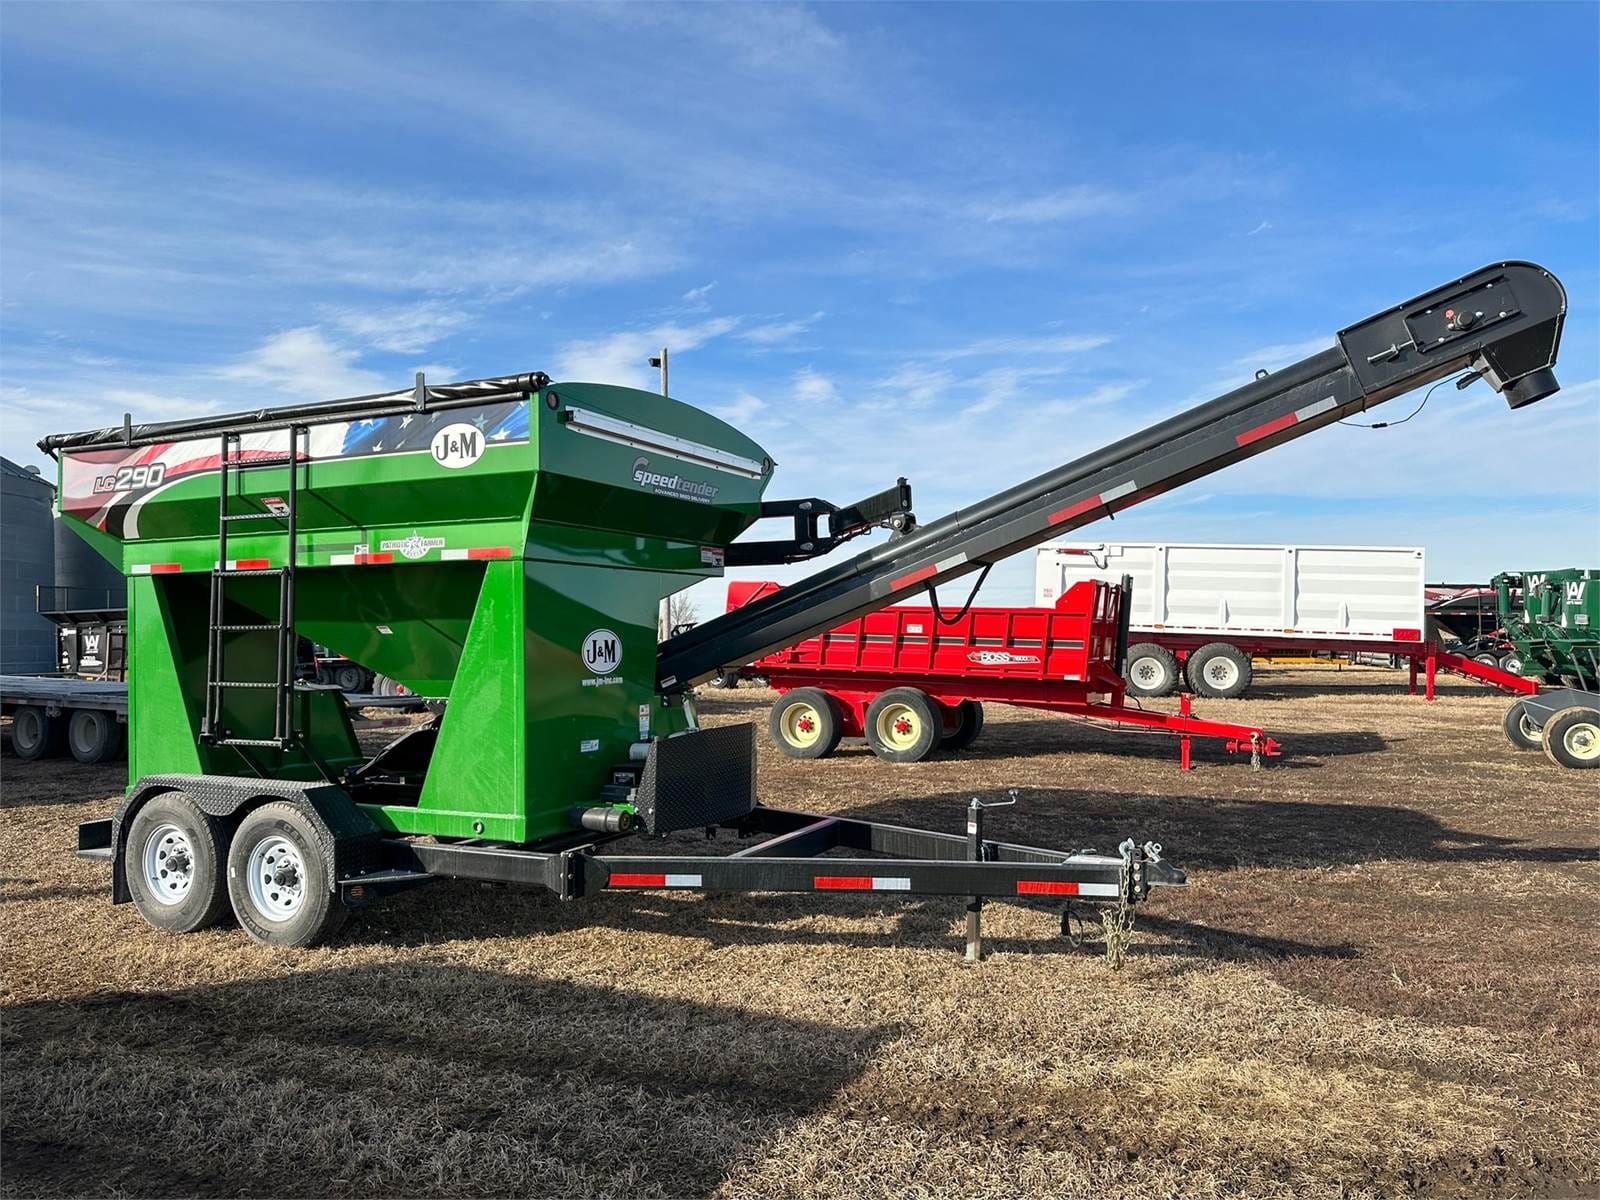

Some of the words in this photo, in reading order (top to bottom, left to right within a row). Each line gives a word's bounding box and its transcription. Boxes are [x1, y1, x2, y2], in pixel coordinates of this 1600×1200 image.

[435, 431, 478, 461] J&M
[587, 640, 616, 664] J&M
[980, 651, 1011, 664] BOSS
